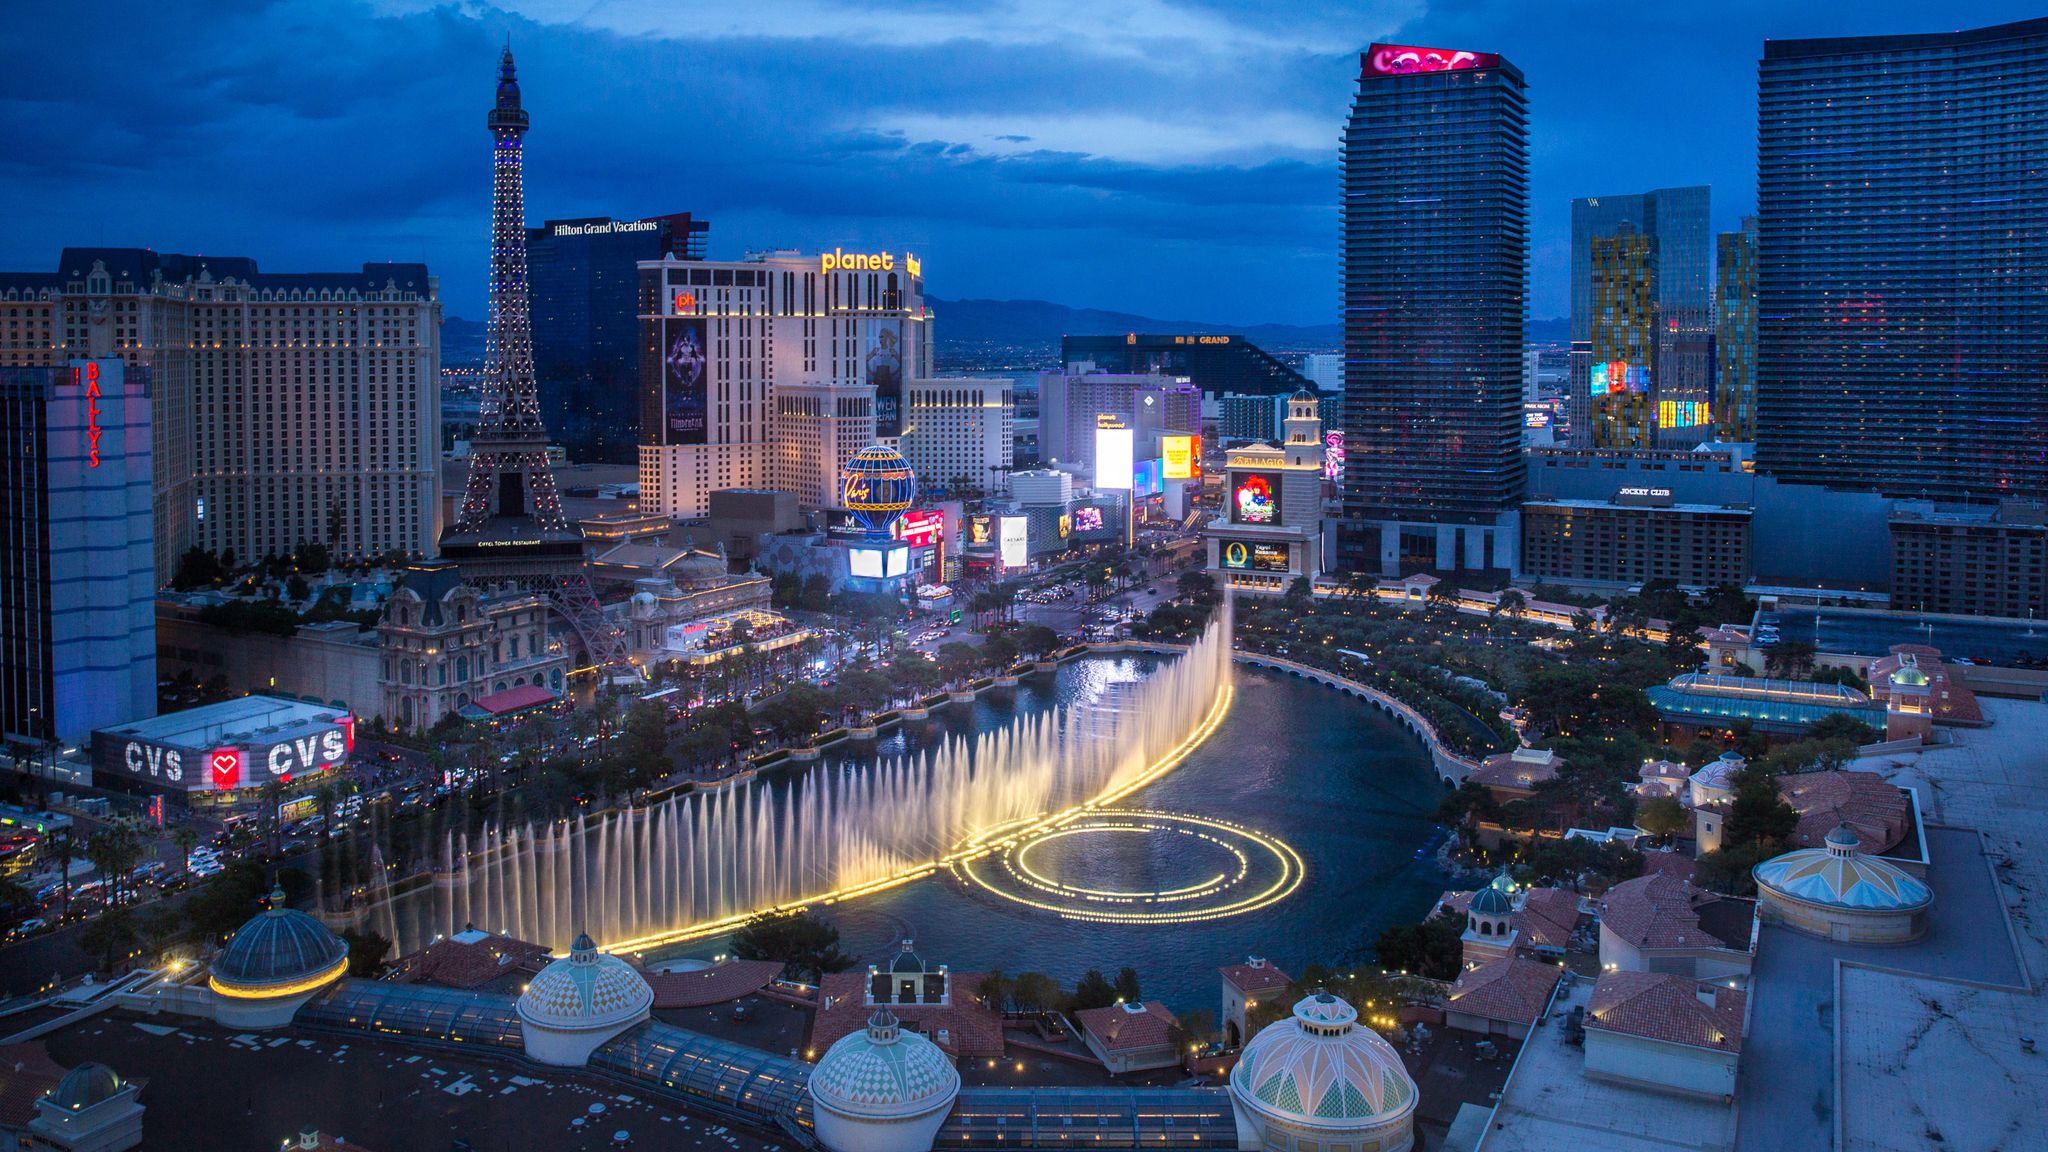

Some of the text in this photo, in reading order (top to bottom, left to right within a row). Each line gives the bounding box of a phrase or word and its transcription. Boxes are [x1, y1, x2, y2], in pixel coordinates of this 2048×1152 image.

[554, 220, 657, 236] Hilton Grand Vacations
[822, 247, 894, 275] planet
[1199, 336, 1230, 344] GRAND
[1234, 456, 1285, 466] BELLAGIO
[844, 473, 870, 508] Paris
[125, 741, 183, 782] CVS
[268, 730, 344, 775] CVS
